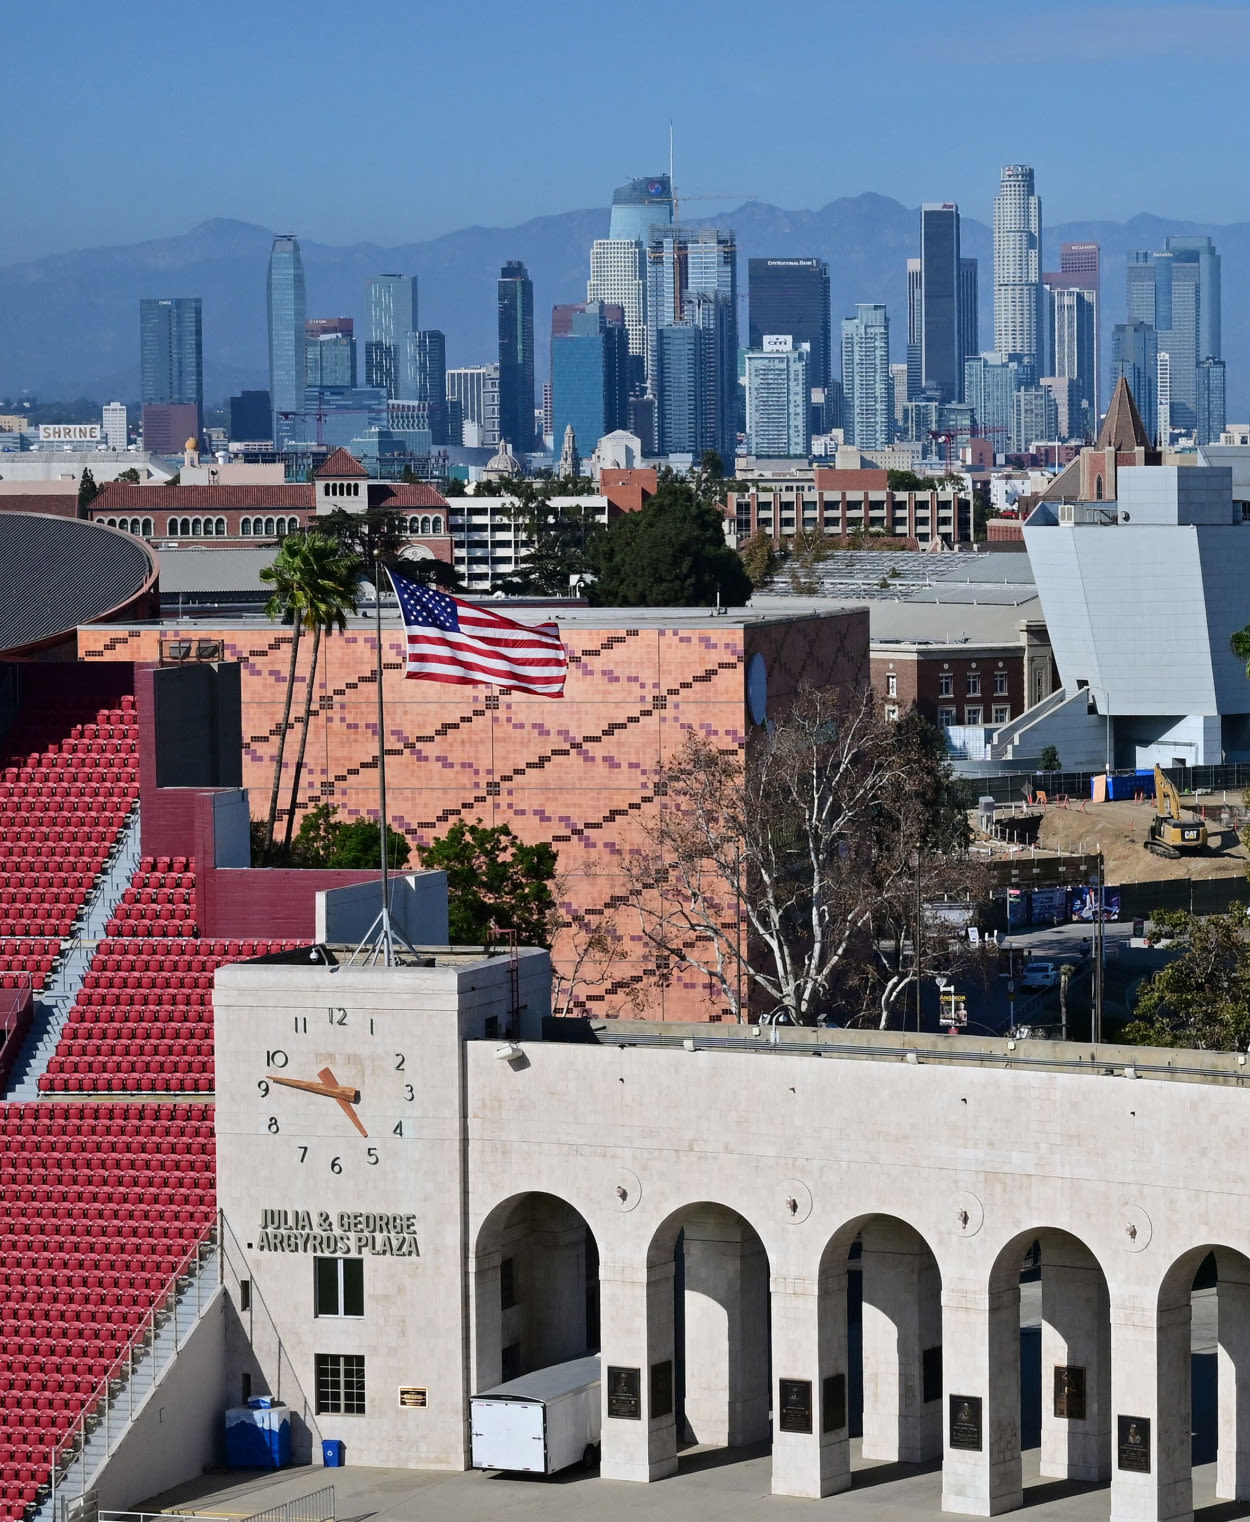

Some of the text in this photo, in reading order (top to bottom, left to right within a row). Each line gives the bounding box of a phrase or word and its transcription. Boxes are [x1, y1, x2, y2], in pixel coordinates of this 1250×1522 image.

[43, 426, 97, 439] SHRINE
[1185, 830, 1197, 839] CAT
[294, 1016, 307, 1034] 11
[328, 1008, 348, 1026] 12
[369, 1018, 374, 1036] 1
[266, 1050, 289, 1068] 10
[395, 1053, 405, 1071] 2
[257, 1080, 270, 1098] 9
[403, 1083, 415, 1101] 3
[267, 1116, 280, 1134] 8
[392, 1120, 403, 1137] 4
[298, 1146, 308, 1163] 7
[367, 1147, 379, 1165] 5
[330, 1156, 343, 1175] 6
[260, 1208, 417, 1235] JULIA & GEORGE
[257, 1231, 421, 1257] ARGYROS PLAZA
